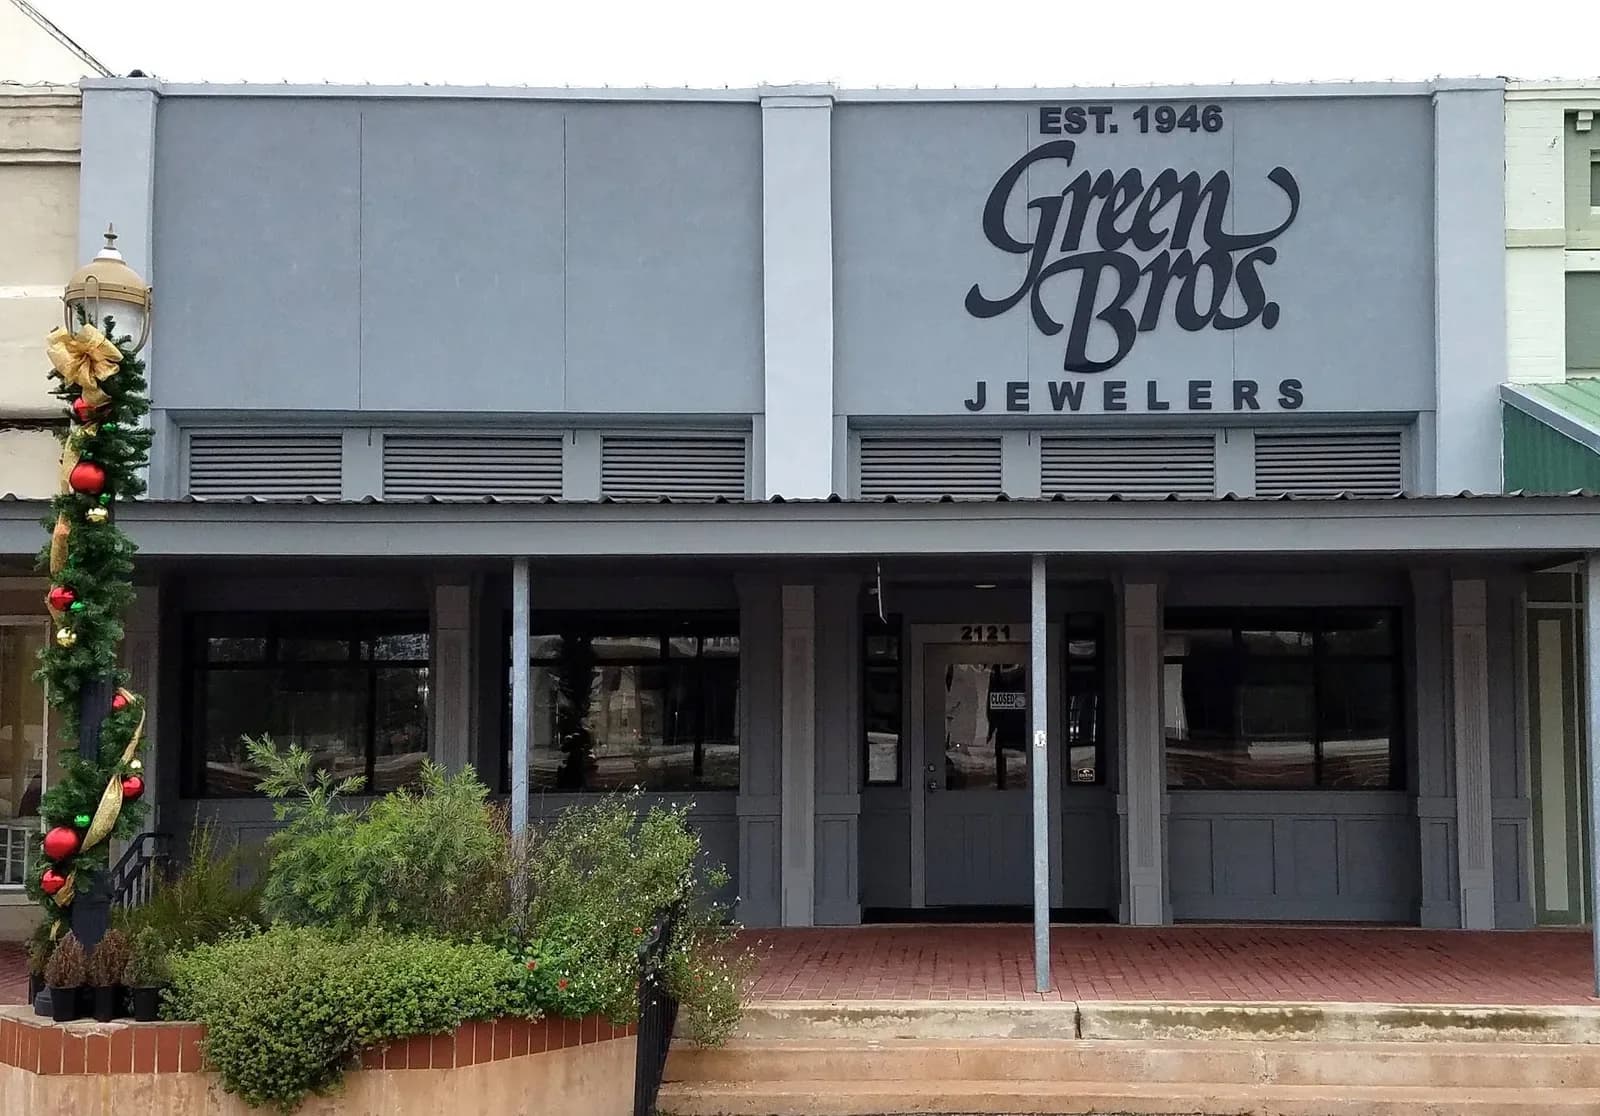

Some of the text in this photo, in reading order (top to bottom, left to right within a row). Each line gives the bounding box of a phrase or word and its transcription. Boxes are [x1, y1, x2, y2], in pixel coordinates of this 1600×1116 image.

[1039, 104, 1224, 134] EST. 1946
[964, 139, 1300, 318] Green
[1030, 246, 1280, 373] Bros.
[964, 379, 1304, 412] JEWELERS
[961, 625, 1010, 640] 2121
[991, 693, 1015, 705] CLOSED
